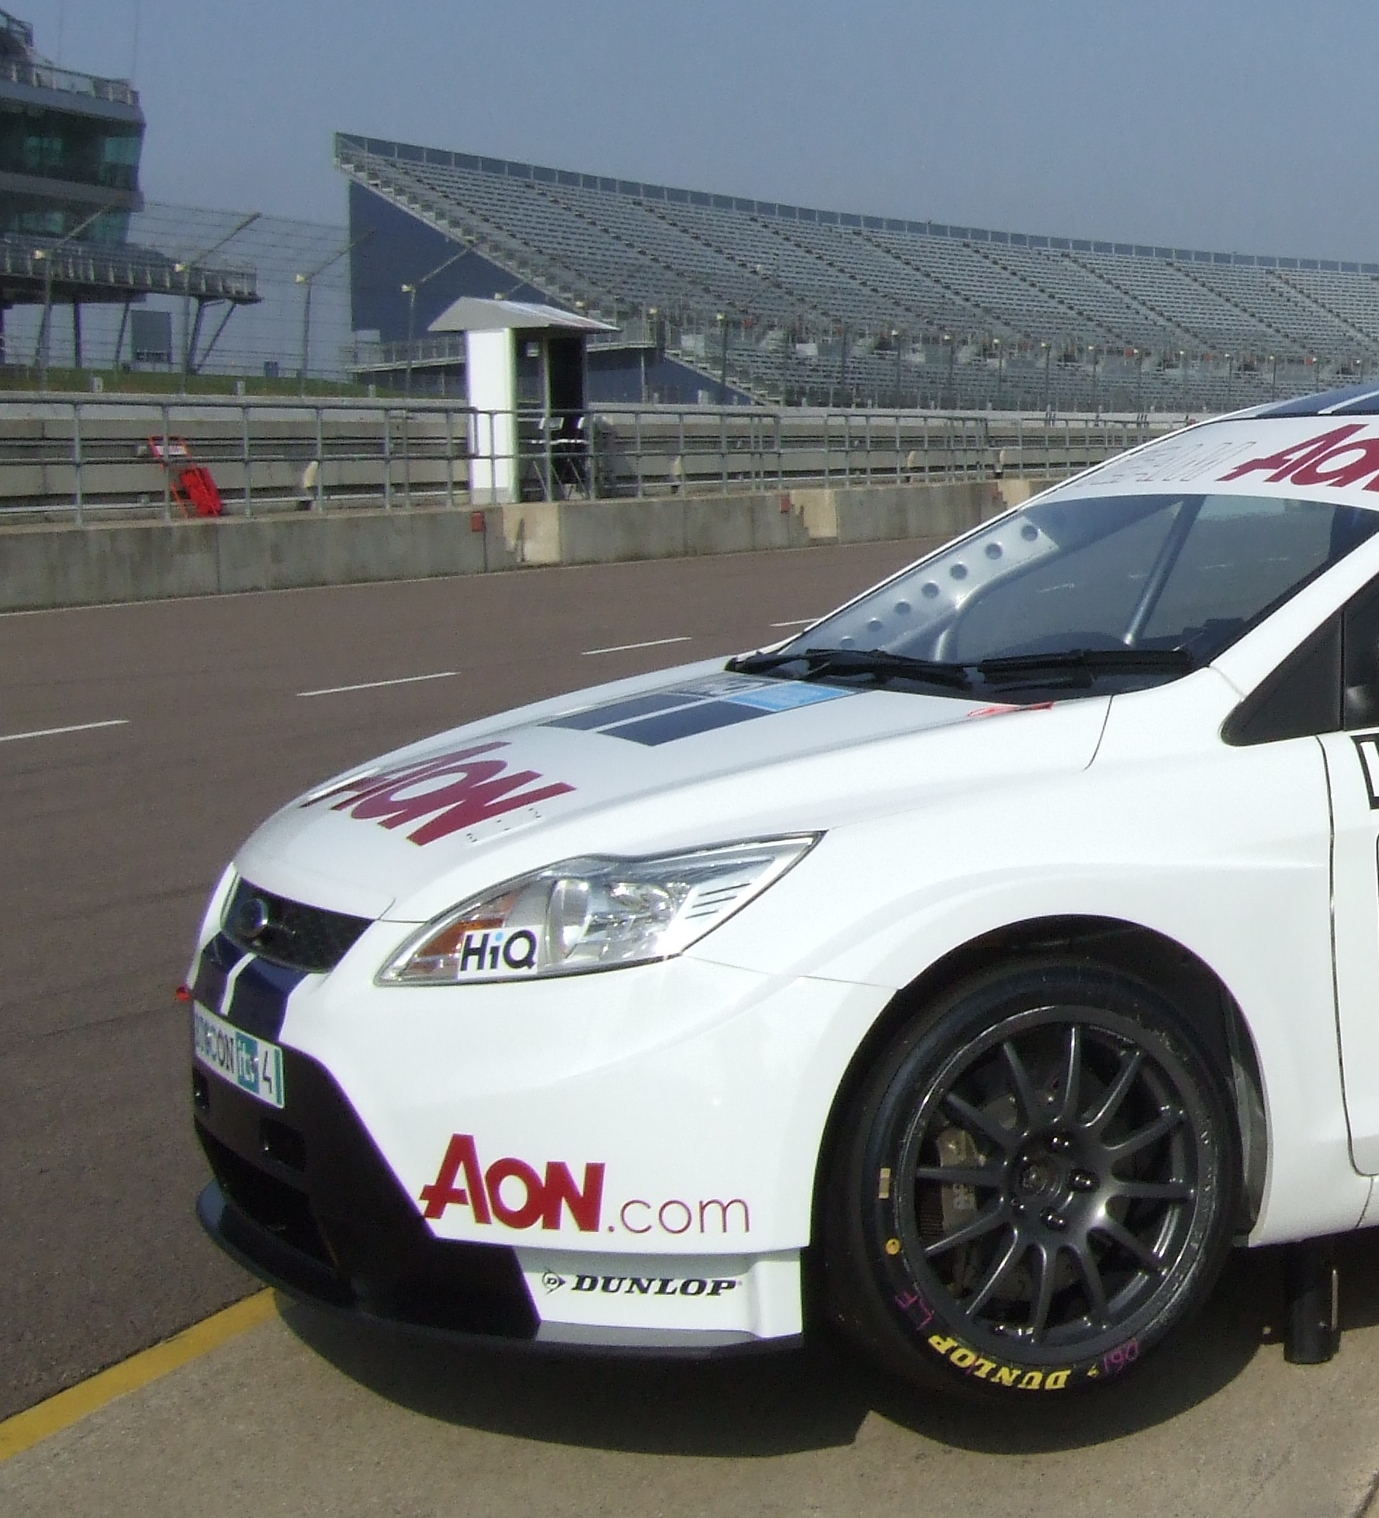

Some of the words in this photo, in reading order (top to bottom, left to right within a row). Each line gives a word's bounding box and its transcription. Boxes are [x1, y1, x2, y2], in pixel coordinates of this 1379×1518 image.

[300, 741, 577, 846] AON
[460, 931, 538, 973] HiQ
[571, 1274, 737, 1297] DUNLOP
[928, 1334, 1072, 1389] DUNLOP
